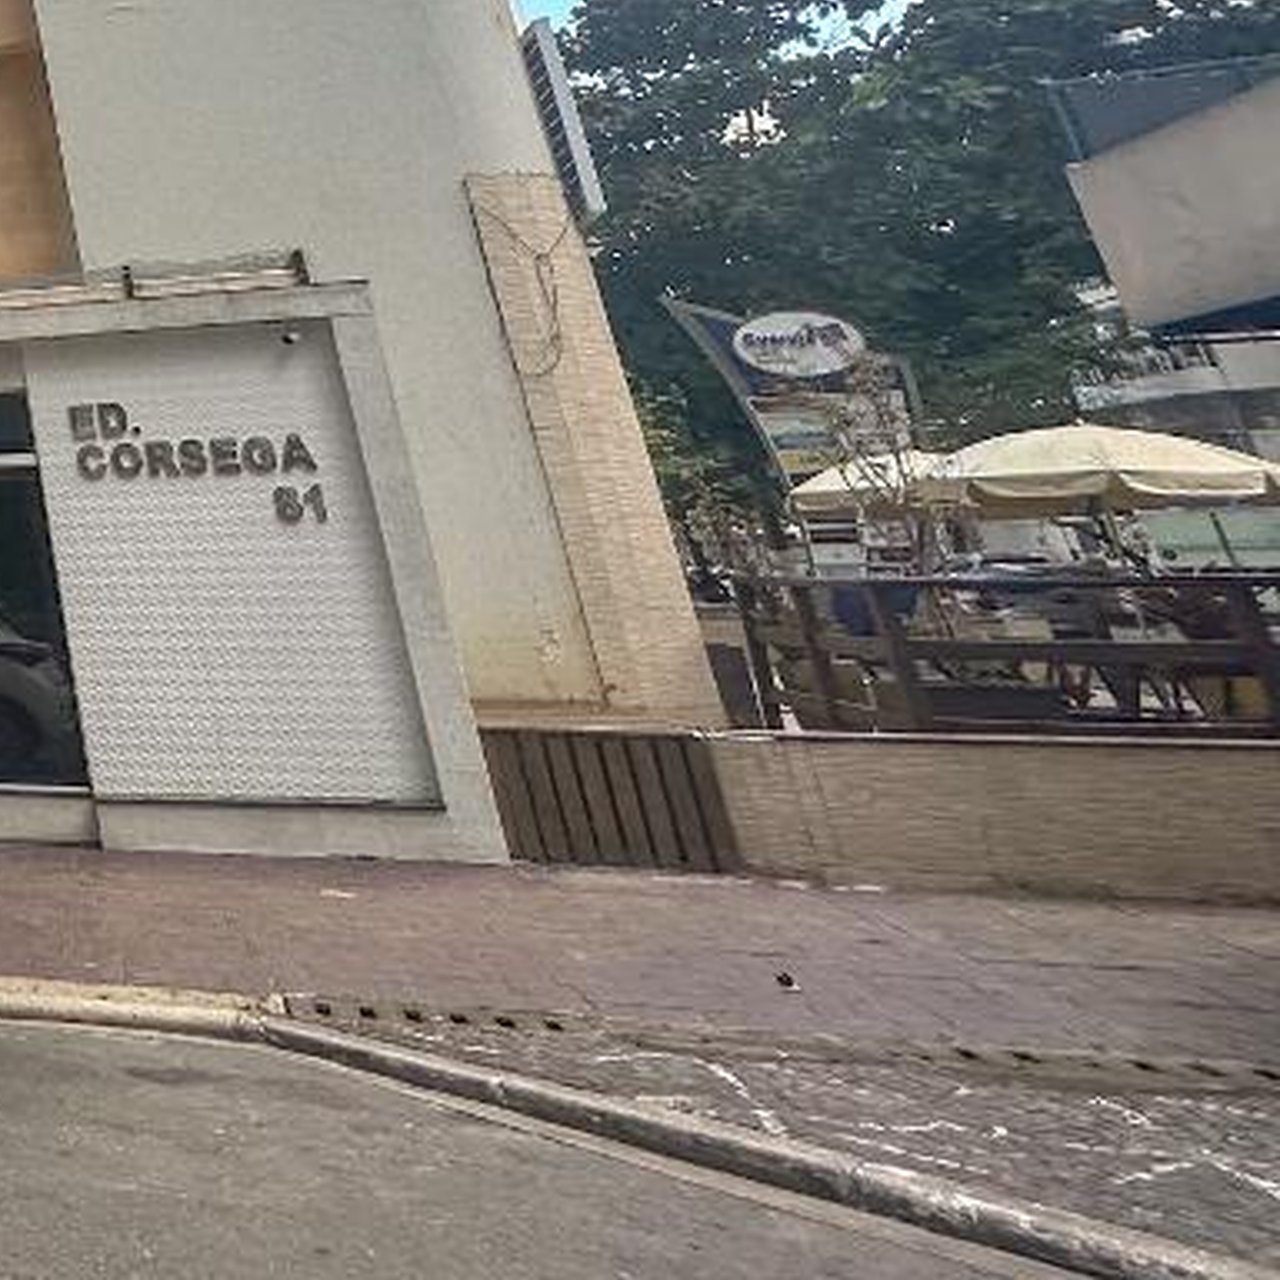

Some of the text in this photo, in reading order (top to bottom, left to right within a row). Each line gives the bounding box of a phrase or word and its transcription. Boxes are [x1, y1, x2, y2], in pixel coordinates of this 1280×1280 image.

[68, 402, 141, 442] ED.
[76, 433, 318, 481] CORSEGA
[272, 483, 328, 525] 81
